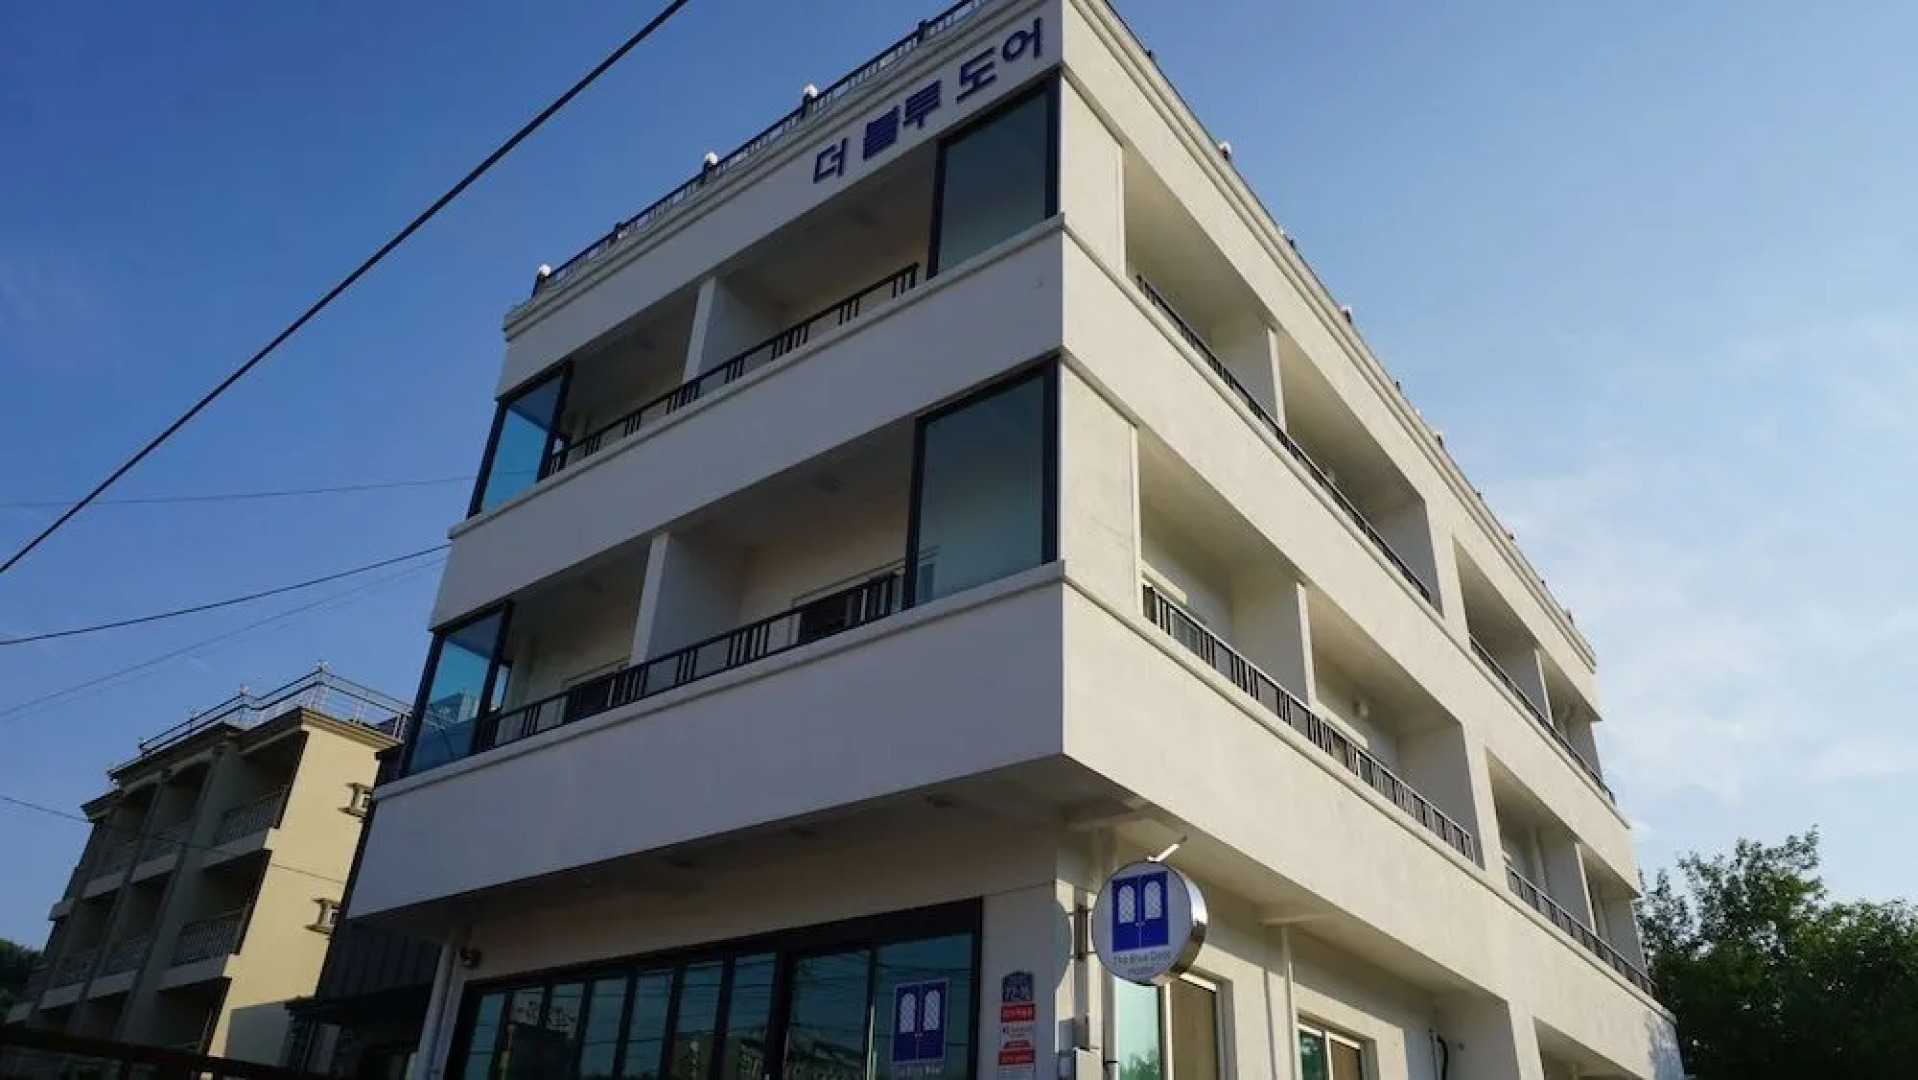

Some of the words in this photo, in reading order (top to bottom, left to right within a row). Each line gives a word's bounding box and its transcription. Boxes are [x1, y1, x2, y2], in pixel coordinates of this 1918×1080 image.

[814, 137, 848, 184] 더
[863, 79, 942, 161] 블루
[956, 16, 1042, 104] 도어
